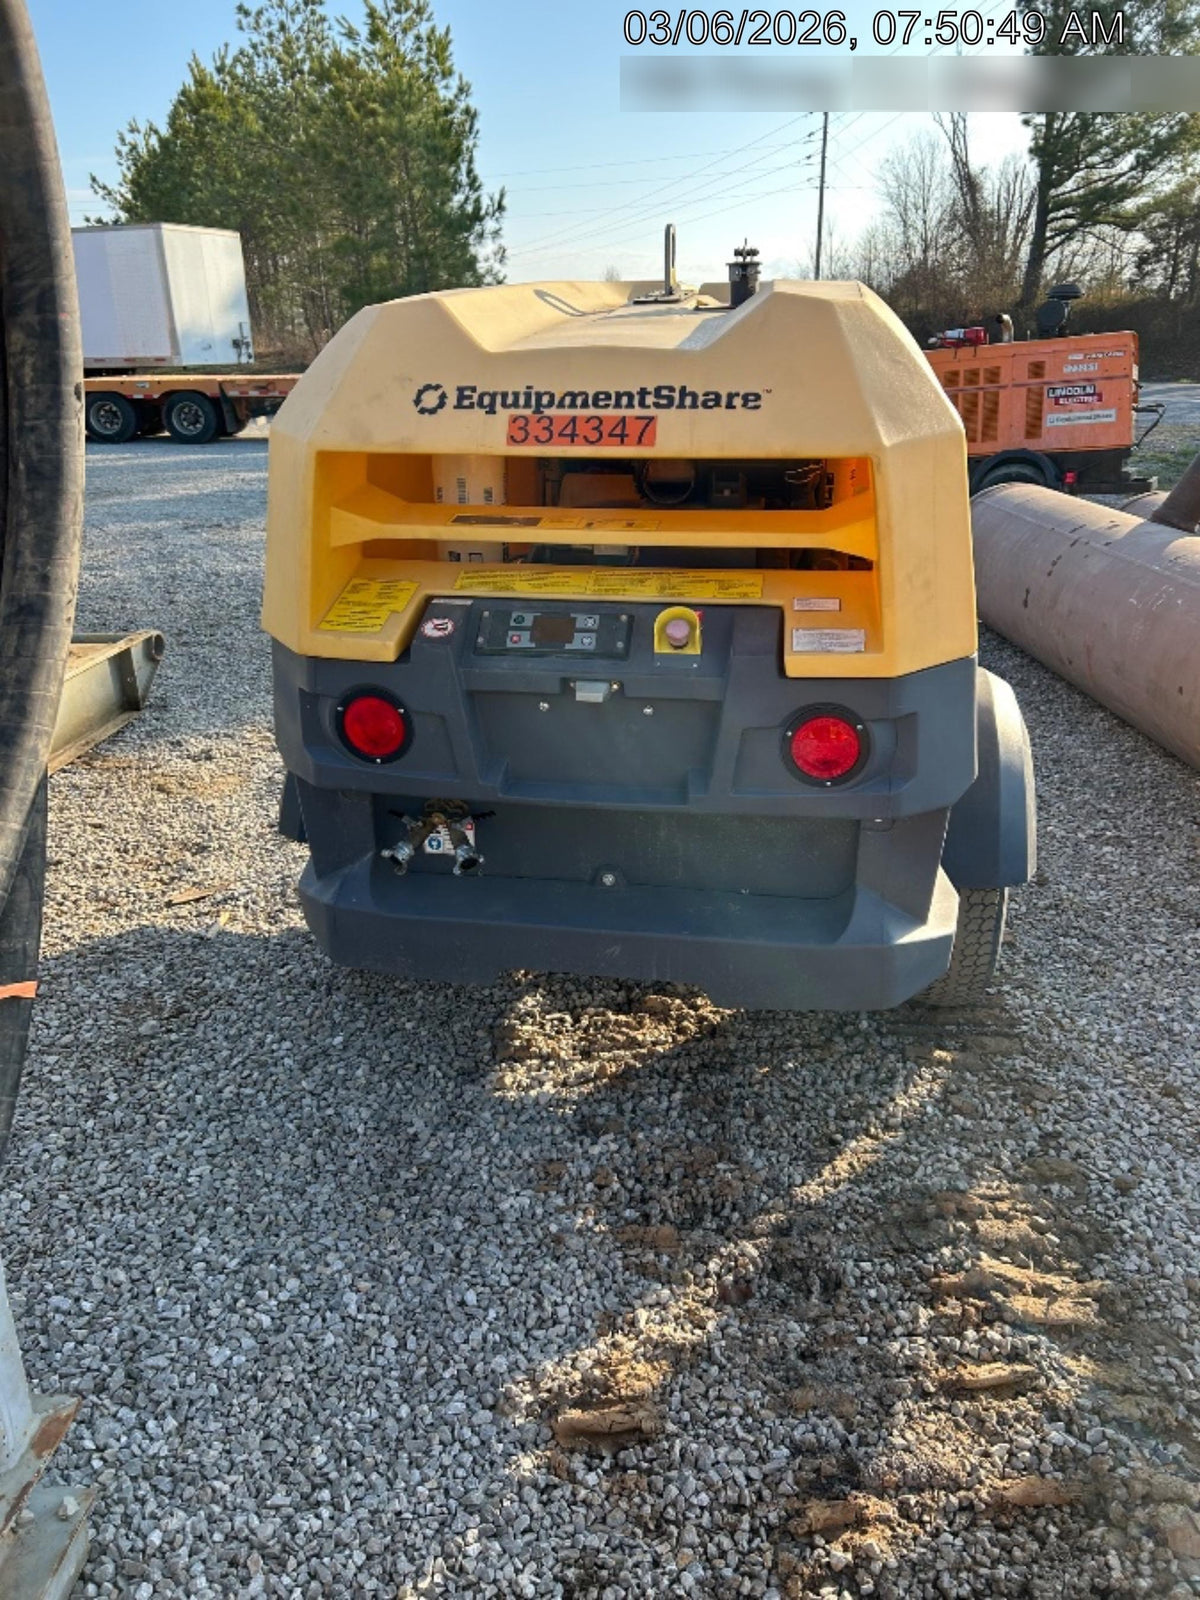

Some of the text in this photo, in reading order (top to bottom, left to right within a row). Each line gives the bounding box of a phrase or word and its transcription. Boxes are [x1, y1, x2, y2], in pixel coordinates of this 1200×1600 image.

[453, 385, 762, 414] EquipmentShare
[1048, 386, 1094, 397] LINCOLN
[510, 416, 655, 445] 334347
